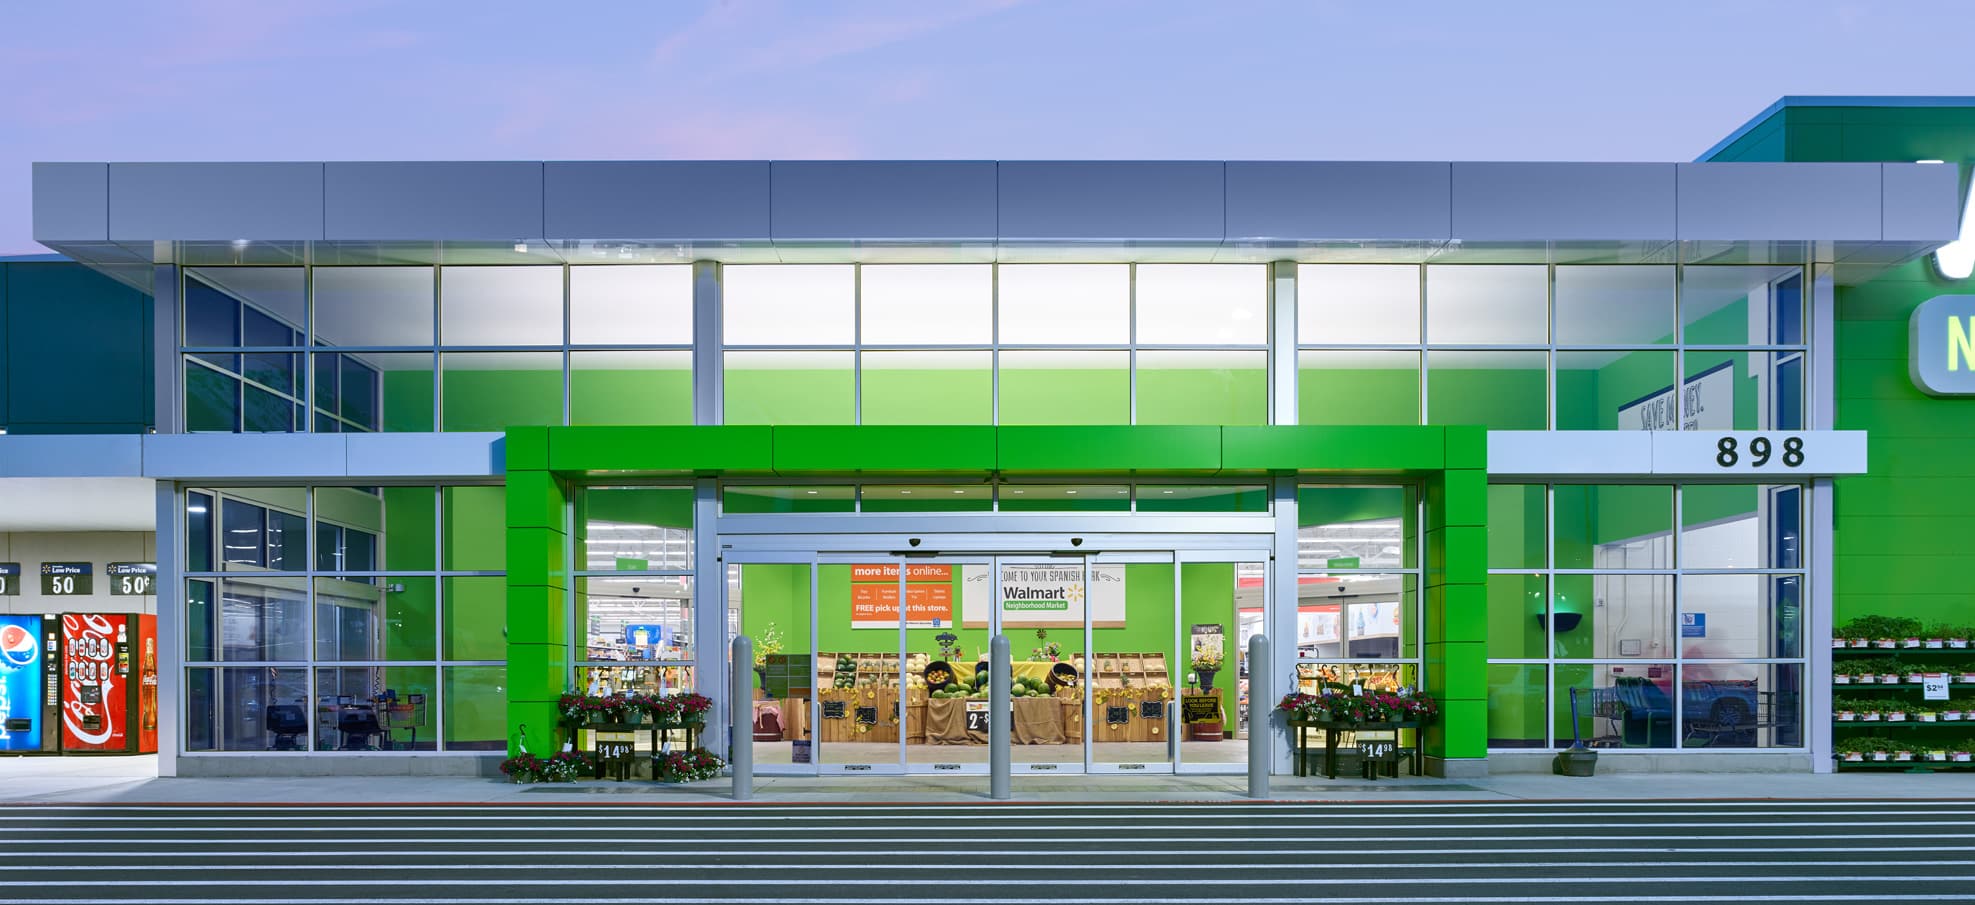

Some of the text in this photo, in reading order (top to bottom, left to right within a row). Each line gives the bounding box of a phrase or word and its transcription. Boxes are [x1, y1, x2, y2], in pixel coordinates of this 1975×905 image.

[1665, 382, 1704, 426] MNEY.
[1716, 437, 1804, 467] 898
[855, 567, 881, 576] more
[1020, 571, 1029, 581] TO
[1030, 571, 1048, 581] YOUR
[1049, 570, 1080, 582] SPANISH
[53, 577, 74, 594] 50
[1003, 586, 1065, 599] Walmart
[855, 604, 875, 612] FREE
[875, 604, 892, 613] pick
[912, 604, 926, 612] this
[1005, 601, 1046, 609] Neighborhood
